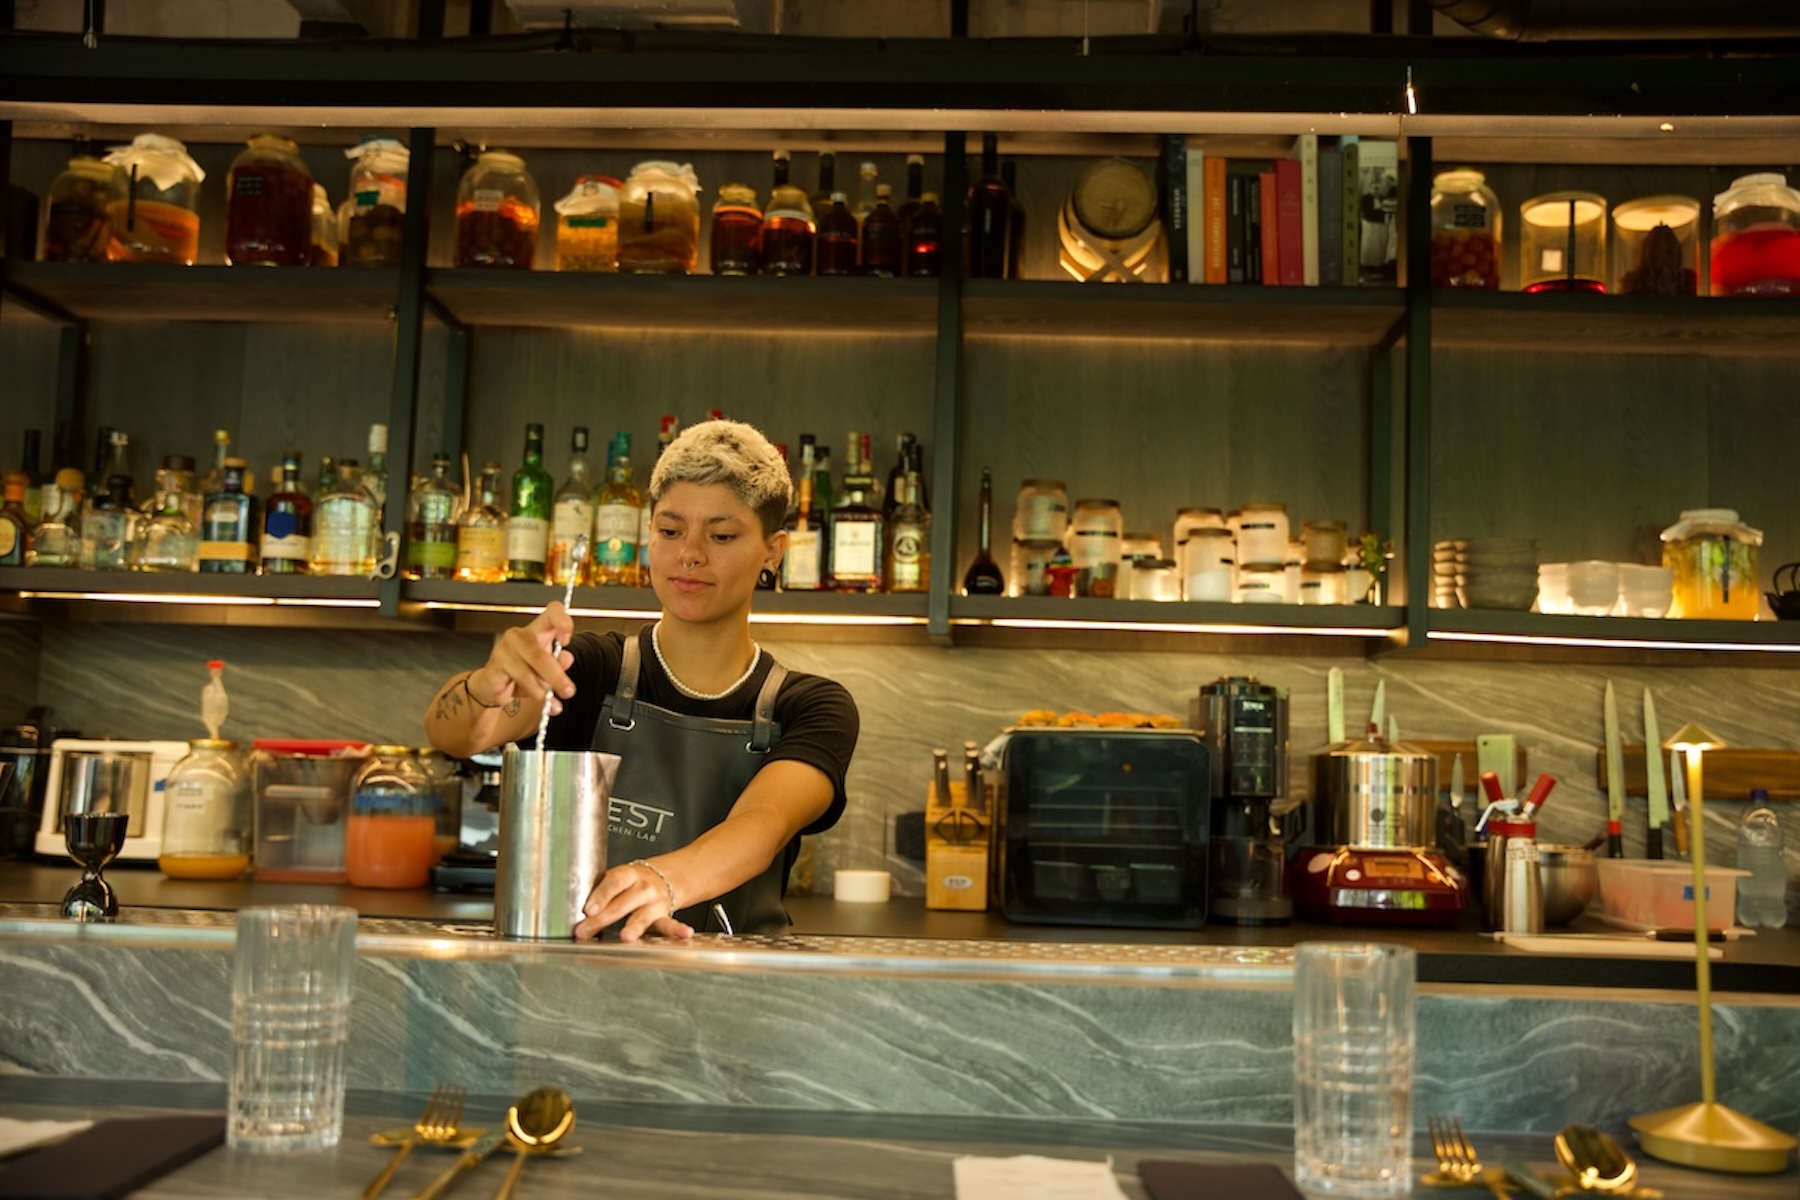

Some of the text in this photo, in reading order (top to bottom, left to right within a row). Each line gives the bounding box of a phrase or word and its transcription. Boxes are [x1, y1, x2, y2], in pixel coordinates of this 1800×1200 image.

[608, 797, 675, 833] EST
[608, 824, 657, 843] CHEN LAB
